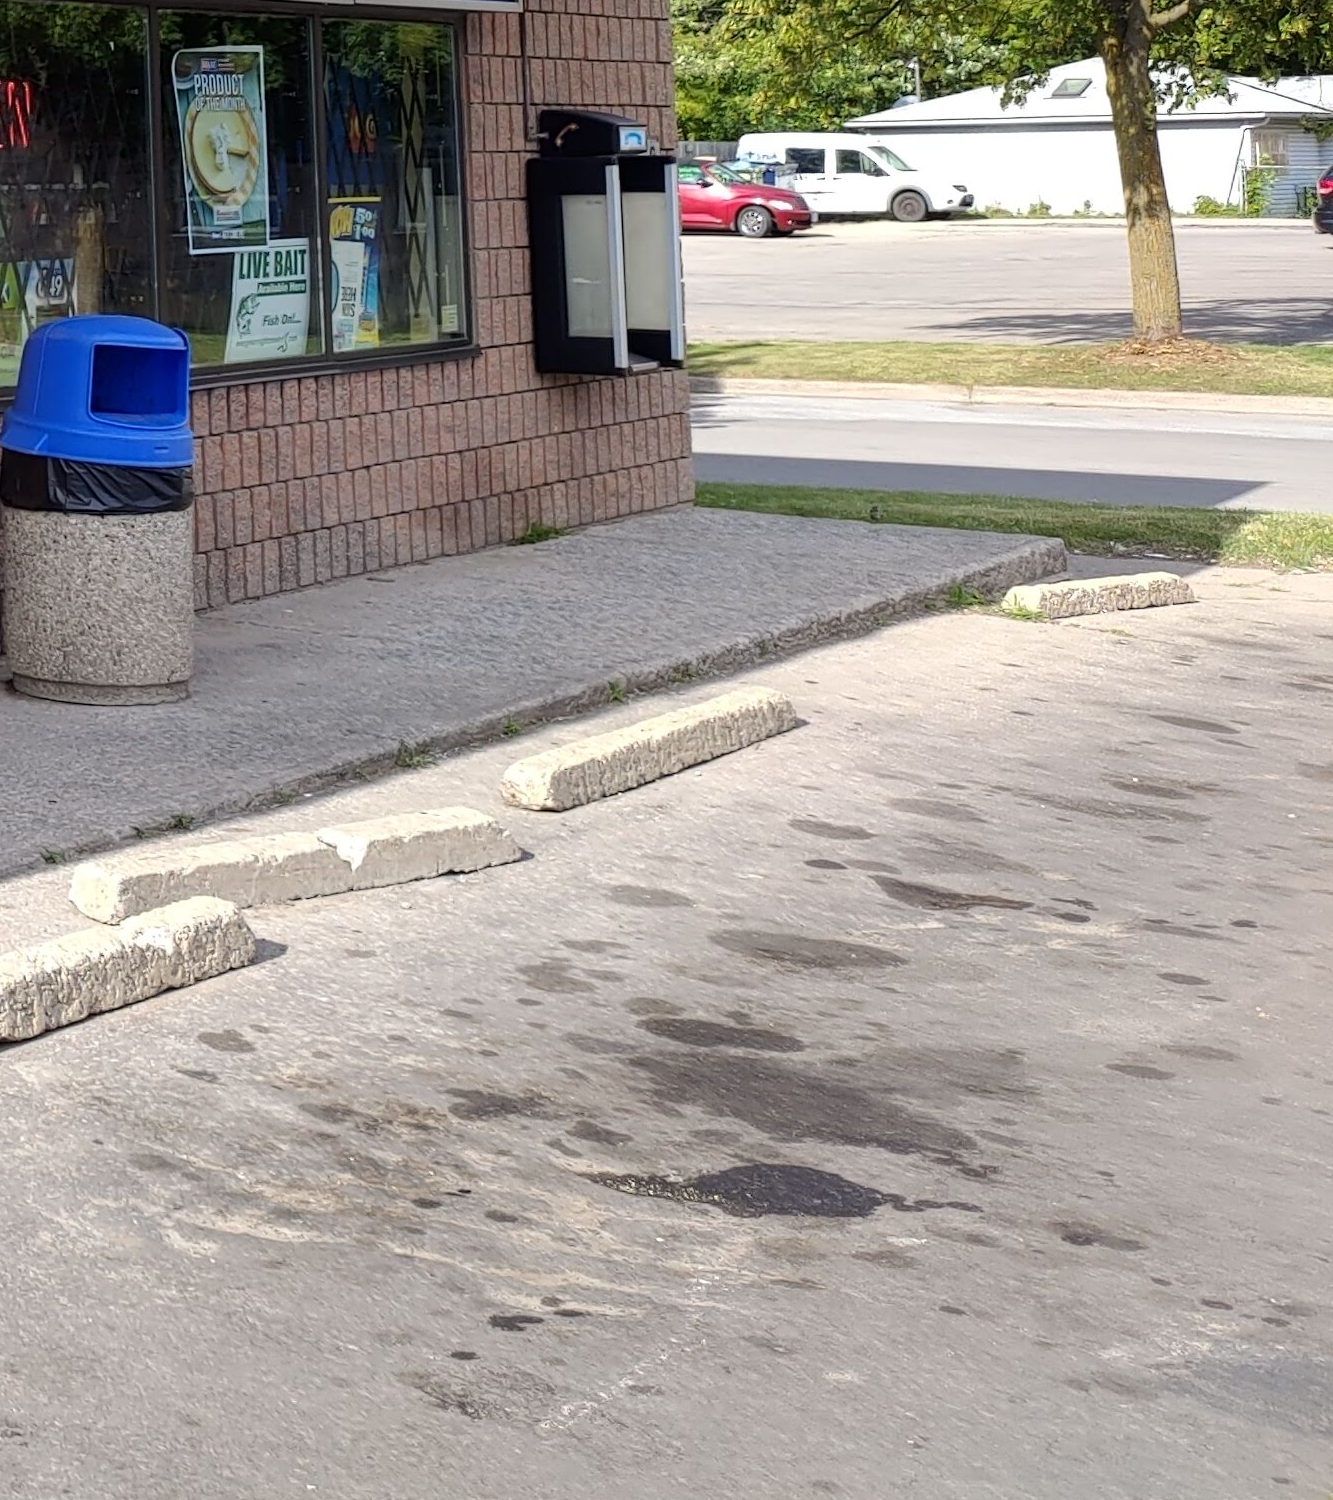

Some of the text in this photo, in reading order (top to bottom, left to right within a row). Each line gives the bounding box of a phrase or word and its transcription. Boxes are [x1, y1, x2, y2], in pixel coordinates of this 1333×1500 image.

[193, 73, 245, 96] PRODUCT
[239, 249, 307, 279] LIVE BAIT
